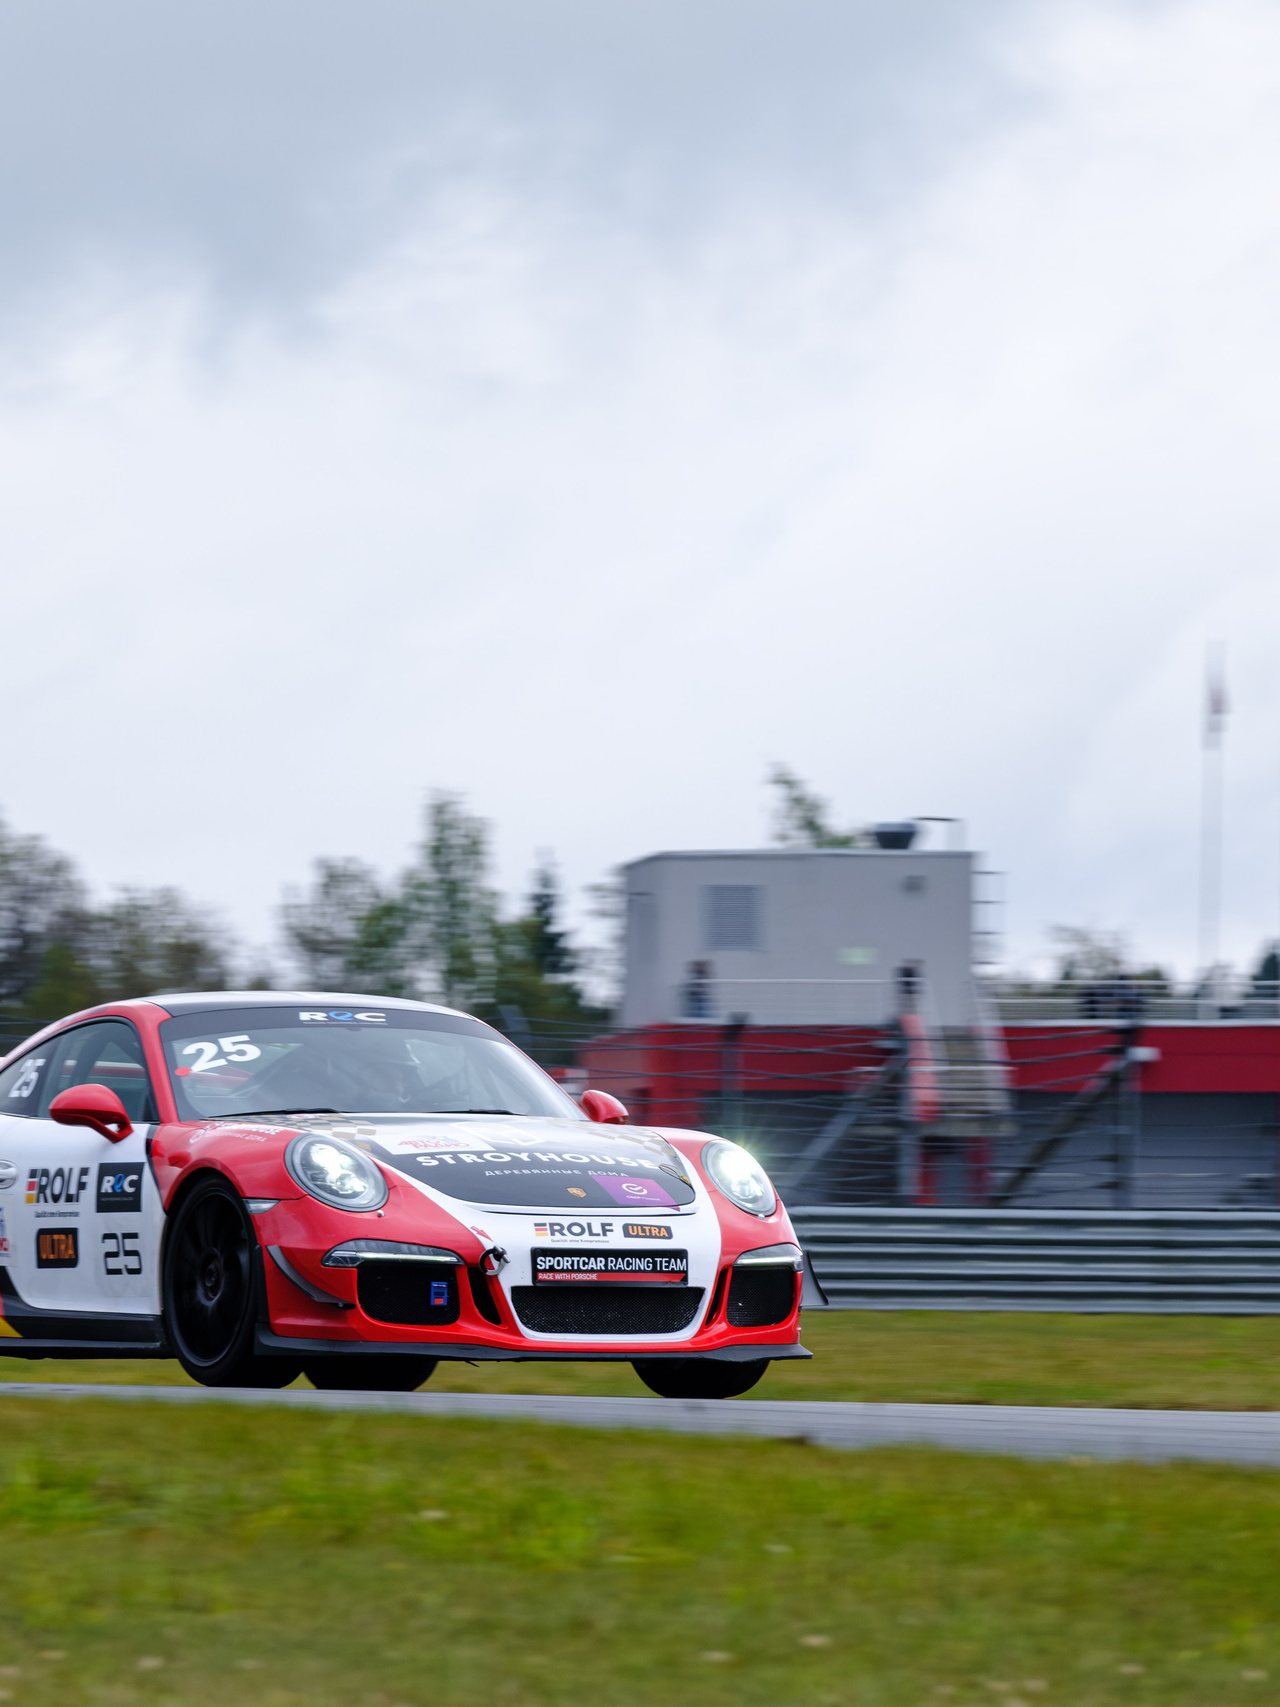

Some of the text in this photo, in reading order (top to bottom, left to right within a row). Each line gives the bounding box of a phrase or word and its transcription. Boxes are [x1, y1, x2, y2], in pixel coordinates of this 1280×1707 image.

[182, 1034, 261, 1073] 25
[8, 1058, 47, 1098] 25
[415, 1152, 660, 1170] STROYHOUSE
[484, 1168, 630, 1178] ДЕРЕВЯННЫЕ ДОМА
[37, 1167, 90, 1204] ROLF
[548, 1222, 614, 1237] ROLF
[628, 1225, 669, 1238] ULTRA
[39, 1234, 76, 1259] ULTRA
[101, 1232, 142, 1276] 25
[536, 1256, 687, 1271] SPORTCAR RACING TEAM
[571, 1273, 598, 1281] PORSCHE
